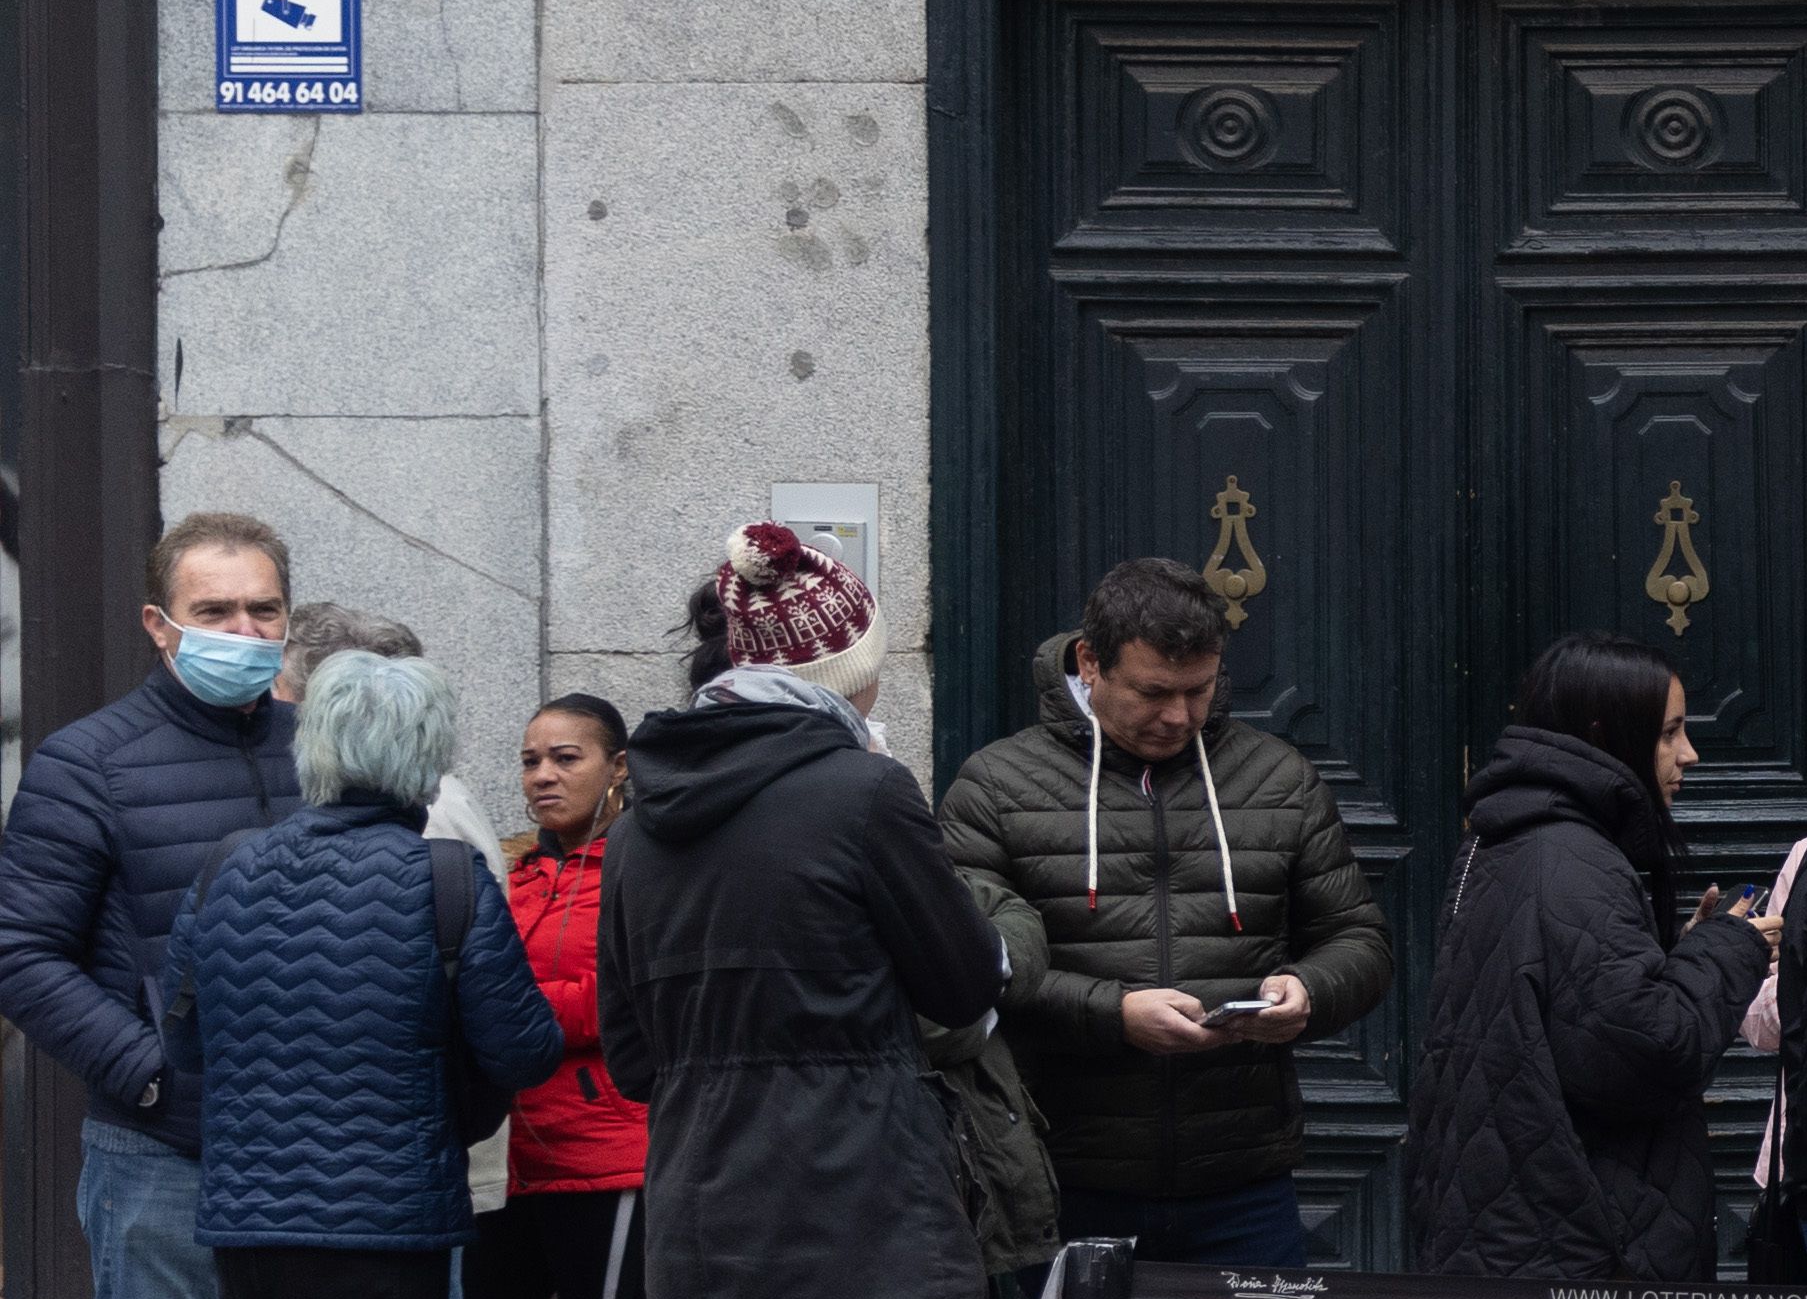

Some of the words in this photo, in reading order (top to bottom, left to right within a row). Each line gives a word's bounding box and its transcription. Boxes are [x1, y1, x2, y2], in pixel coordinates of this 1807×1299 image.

[220, 81, 243, 103] 91
[247, 81, 291, 103] 464
[296, 81, 325, 103] 64
[329, 81, 358, 103] 04
